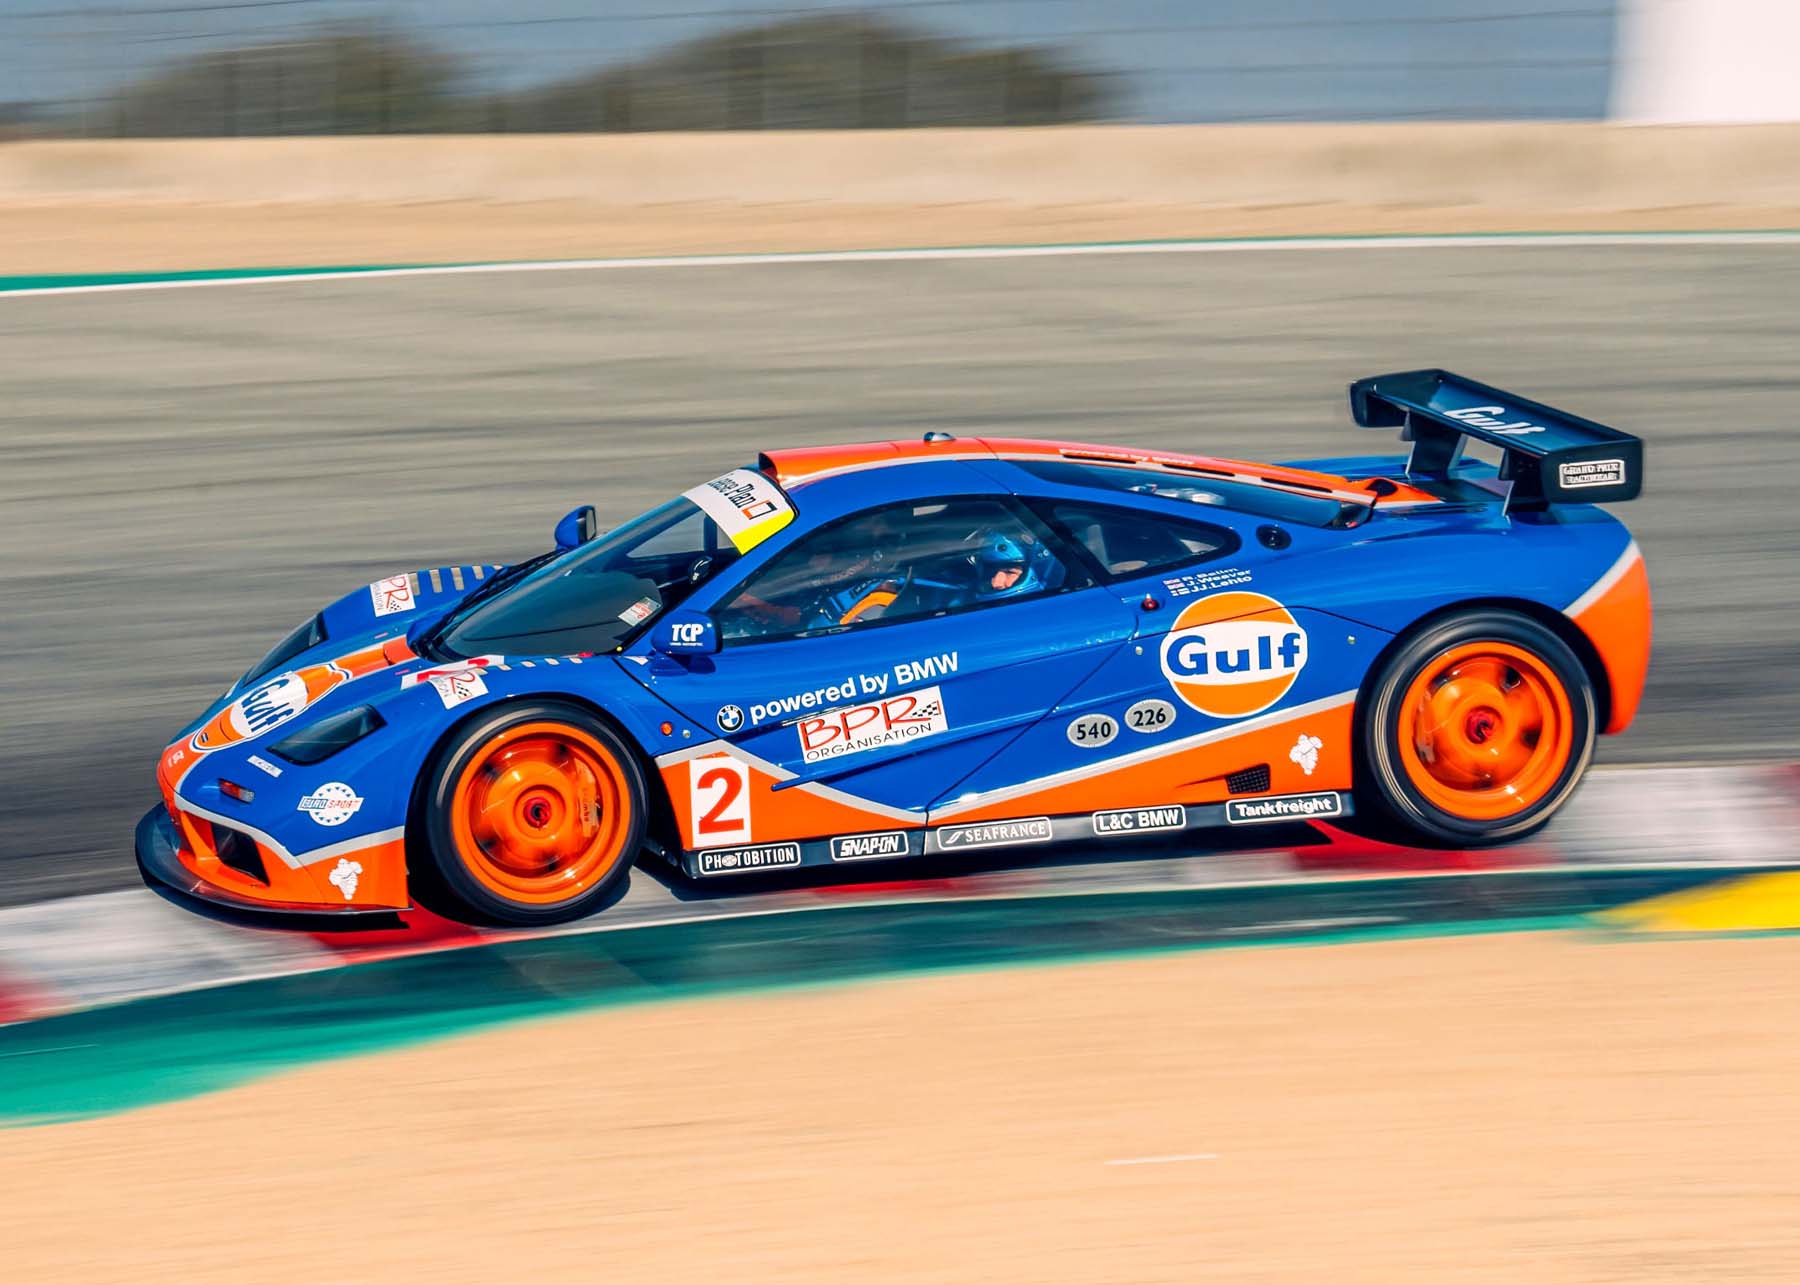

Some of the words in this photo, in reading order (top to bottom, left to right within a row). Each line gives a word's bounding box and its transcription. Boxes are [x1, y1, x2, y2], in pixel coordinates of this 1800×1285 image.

[1443, 406, 1546, 435] Gulf
[724, 483, 756, 509] Plan
[671, 623, 704, 642] TCP
[1166, 632, 1300, 677] Gulf
[749, 677, 857, 725] powered
[860, 672, 889, 695] by
[894, 652, 959, 685] BMW
[240, 678, 295, 733] Gulf
[1133, 708, 1166, 727] 226
[799, 696, 932, 751] BPR
[1076, 721, 1112, 740] 540
[805, 722, 932, 762] ORGANISATION
[697, 767, 745, 835] 2
[1235, 798, 1332, 817] Tankfreight
[965, 821, 1046, 843] SEAFRANCE
[1099, 812, 1134, 831] L&C
[1138, 809, 1179, 828] BMW
[840, 835, 899, 857] SNAP-ON
